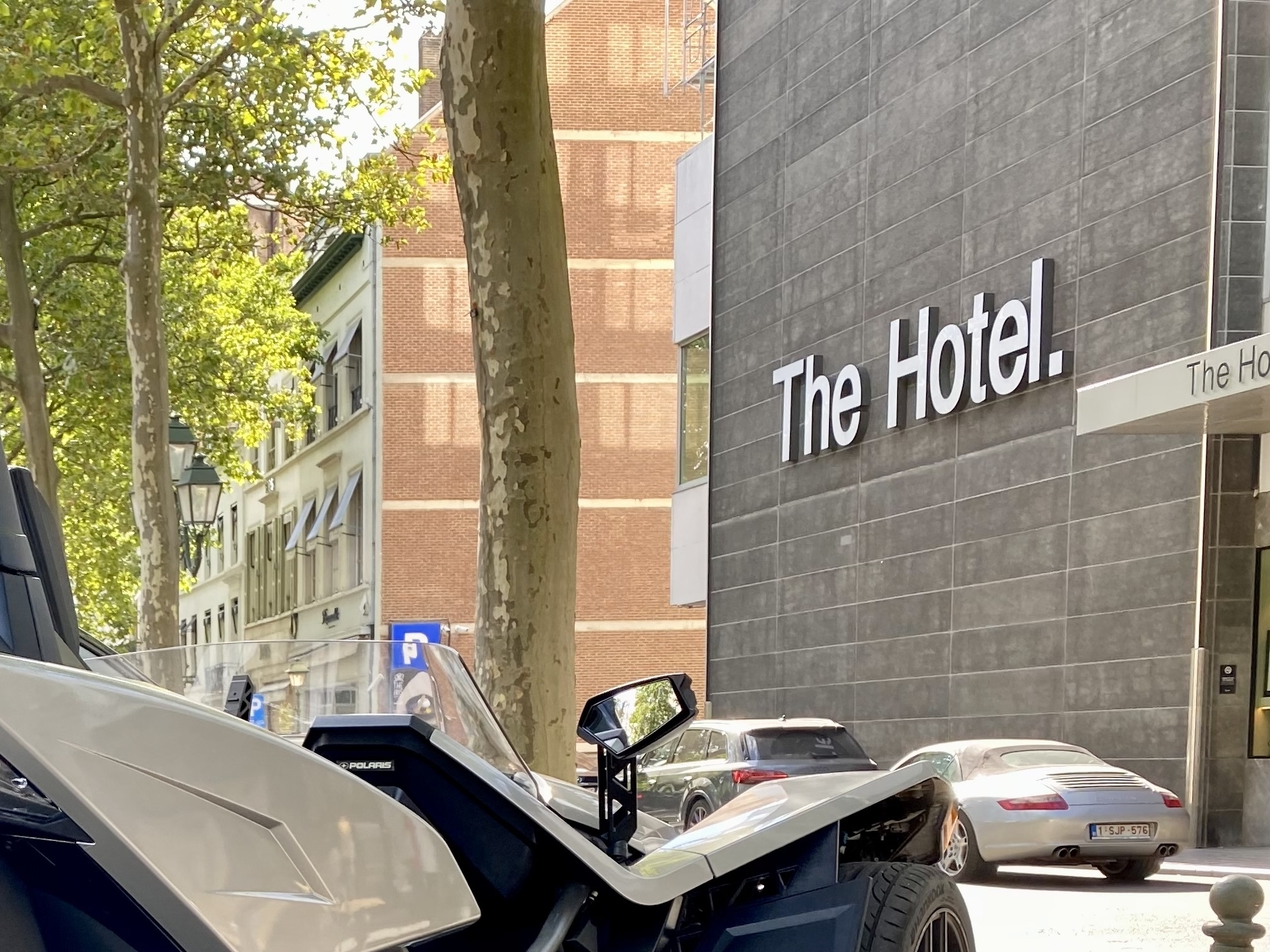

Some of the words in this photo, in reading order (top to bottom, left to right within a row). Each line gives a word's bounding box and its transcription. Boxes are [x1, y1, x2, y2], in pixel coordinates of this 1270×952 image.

[773, 355, 863, 462] The
[887, 257, 1065, 429] Hotel.
[1186, 359, 1230, 396] The
[1238, 344, 1270, 383] Ho
[249, 697, 262, 718] P
[349, 761, 392, 769] POLARIS
